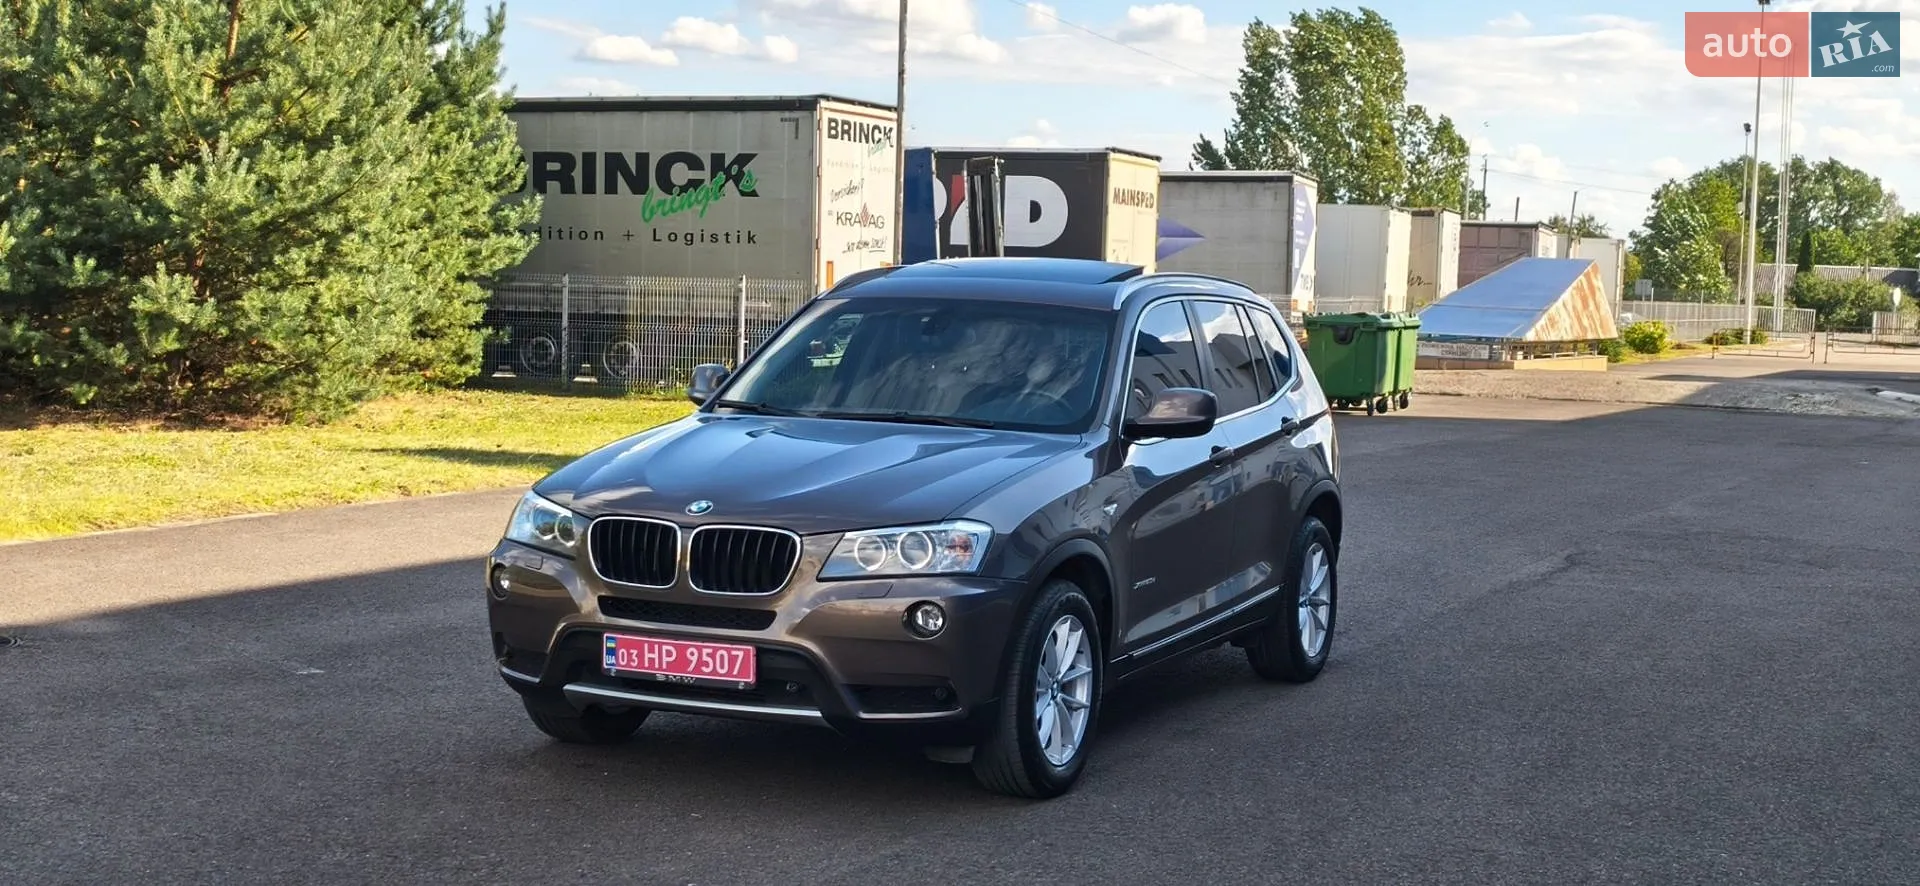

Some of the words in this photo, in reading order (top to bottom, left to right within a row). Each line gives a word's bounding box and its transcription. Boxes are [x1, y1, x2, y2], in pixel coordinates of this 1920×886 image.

[827, 116, 894, 148] BRINCK
[517, 151, 760, 198] RINCK
[836, 203, 886, 230] KRAVAG
[652, 228, 757, 246] Logistik
[606, 655, 616, 665] UA
[618, 648, 638, 667] 03
[644, 643, 677, 669] HP
[686, 647, 744, 675] 9507
